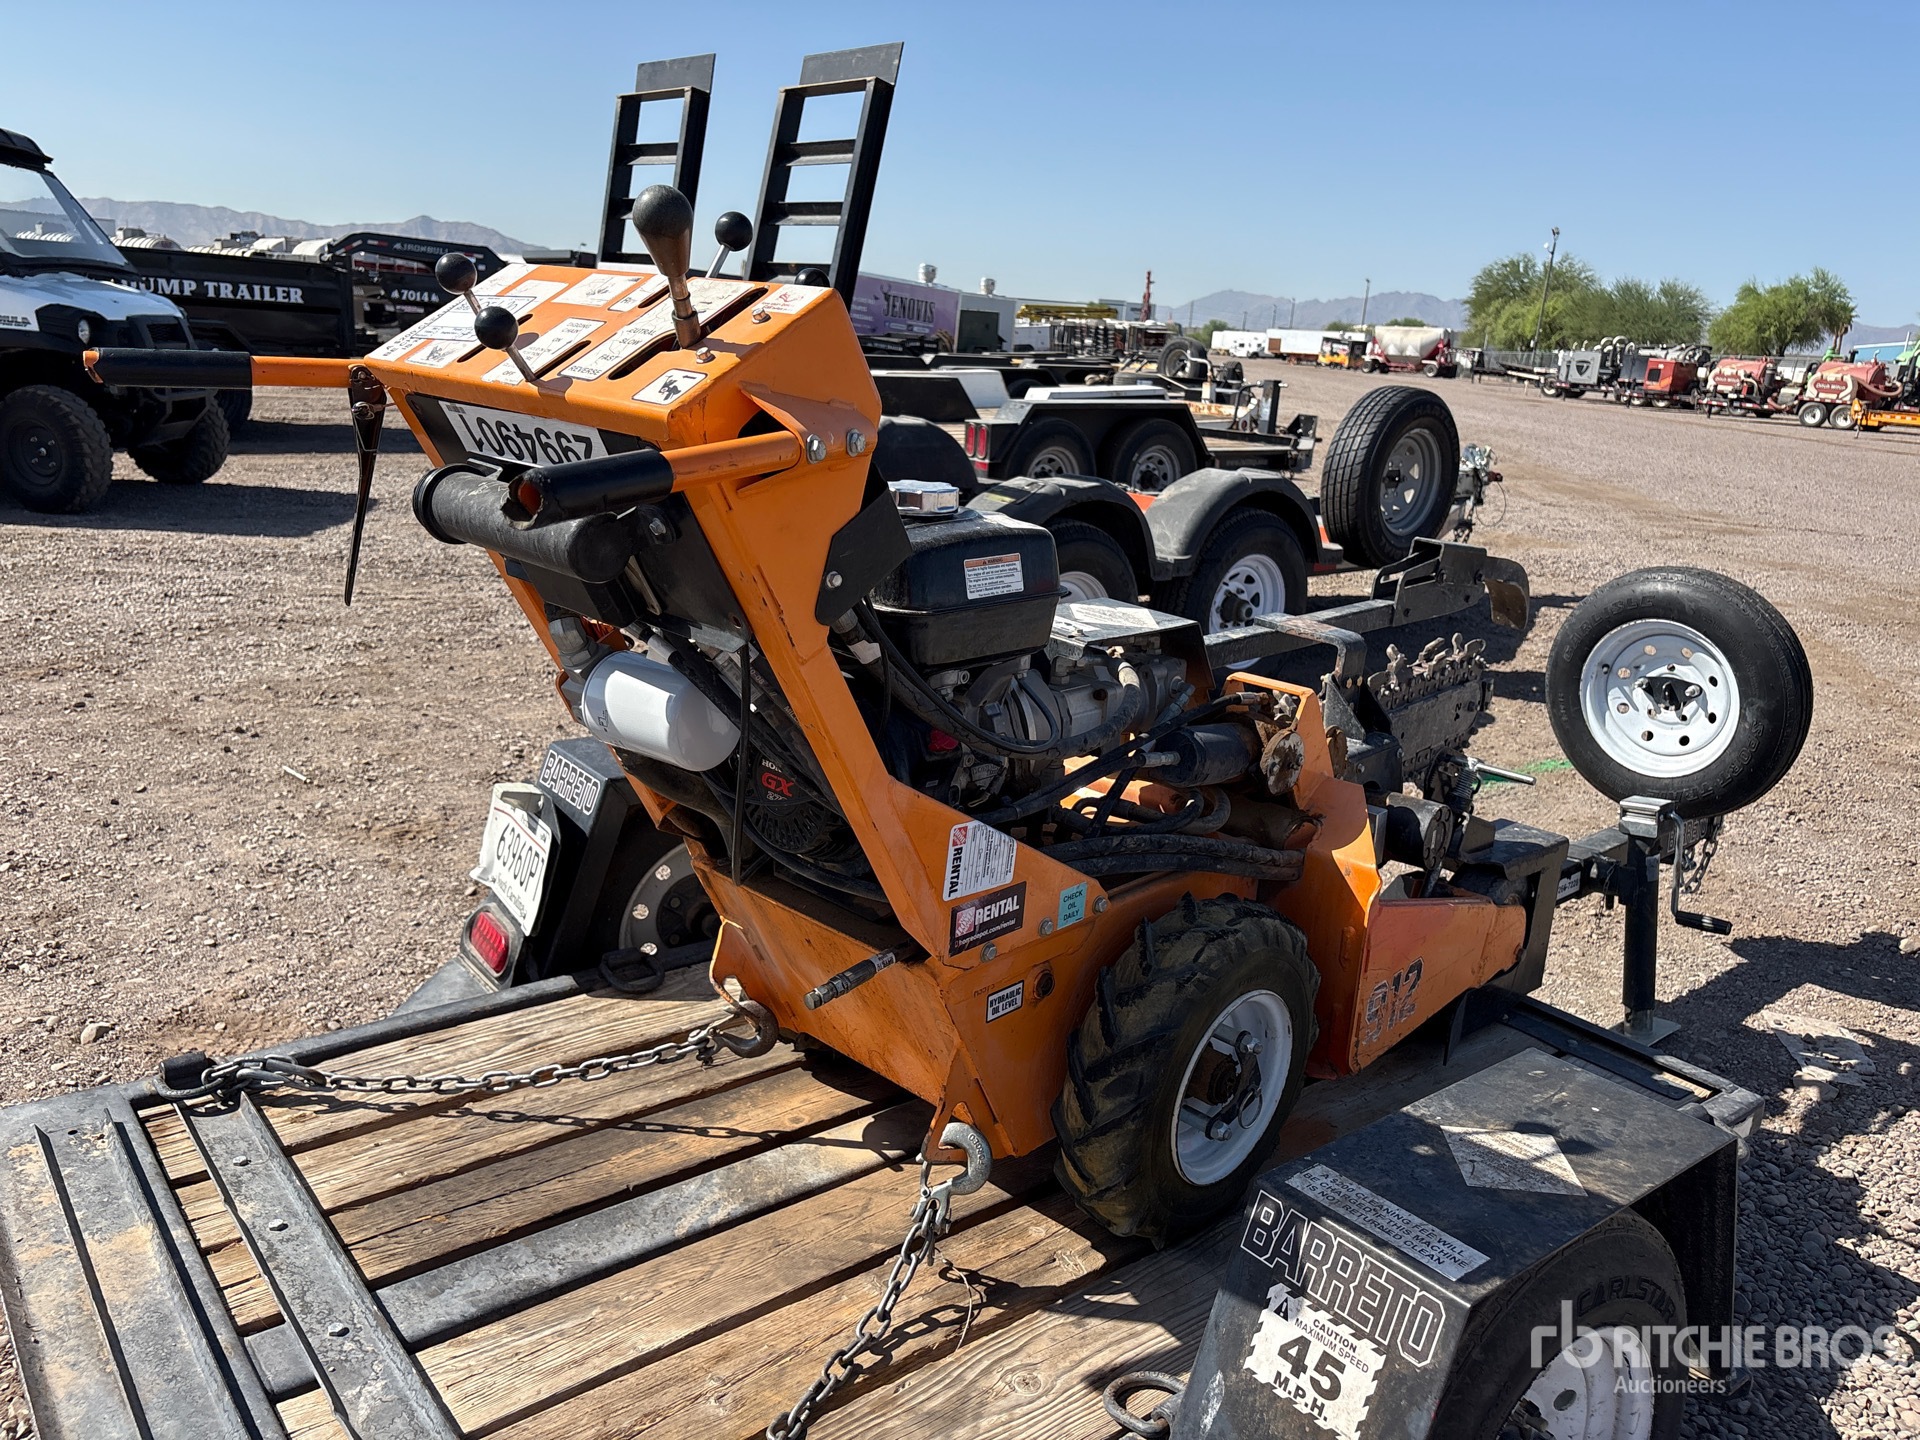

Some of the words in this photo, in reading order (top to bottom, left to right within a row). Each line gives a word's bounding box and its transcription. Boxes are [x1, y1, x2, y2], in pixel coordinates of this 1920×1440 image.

[133, 276, 197, 297] UMP
[203, 281, 304, 304] TRAILER
[401, 289, 429, 302] 7014
[882, 293, 936, 323] JENOVIS
[619, 338, 642, 346] SLOW
[626, 328, 657, 336] EUTRAL
[568, 365, 603, 376] REVERSE
[599, 353, 622, 362] FAST
[1719, 720, 1764, 788] SPORT
[539, 750, 601, 815] BARRETO
[761, 772, 794, 797] GX
[948, 846, 963, 898] RENTAL
[975, 895, 1020, 926] RENTAL
[1063, 889, 1083, 903] CHECK
[1067, 902, 1077, 910] OIL
[1063, 908, 1080, 921] DAILY
[989, 987, 1021, 1008] HYDRAULIC
[991, 1005, 1000, 1016] OIL
[1001, 997, 1018, 1011] LEVEL
[1303, 1172, 1320, 1183] BE
[1320, 1182, 1373, 1213] CHARGED
[1386, 1218, 1413, 1236] THIS
[1412, 1234, 1469, 1269] MACHINE
[1306, 1184, 1318, 1192] IS
[1318, 1190, 1341, 1205] NOT
[1342, 1204, 1403, 1240] RETURNED
[1403, 1240, 1445, 1265] CLEAN
[1330, 1177, 1355, 1193] $200
[1355, 1192, 1411, 1225] CLEANING
[1412, 1224, 1437, 1240] FEE
[1437, 1237, 1466, 1258] WILL
[1240, 1189, 1446, 1368] BARRETO
[1294, 1317, 1338, 1354] MAXIMUM
[1337, 1347, 1370, 1374] SPEED
[1312, 1318, 1358, 1354] CAUTION
[1277, 1335, 1346, 1402] 45
[1272, 1370, 1328, 1422] M.P.H.
